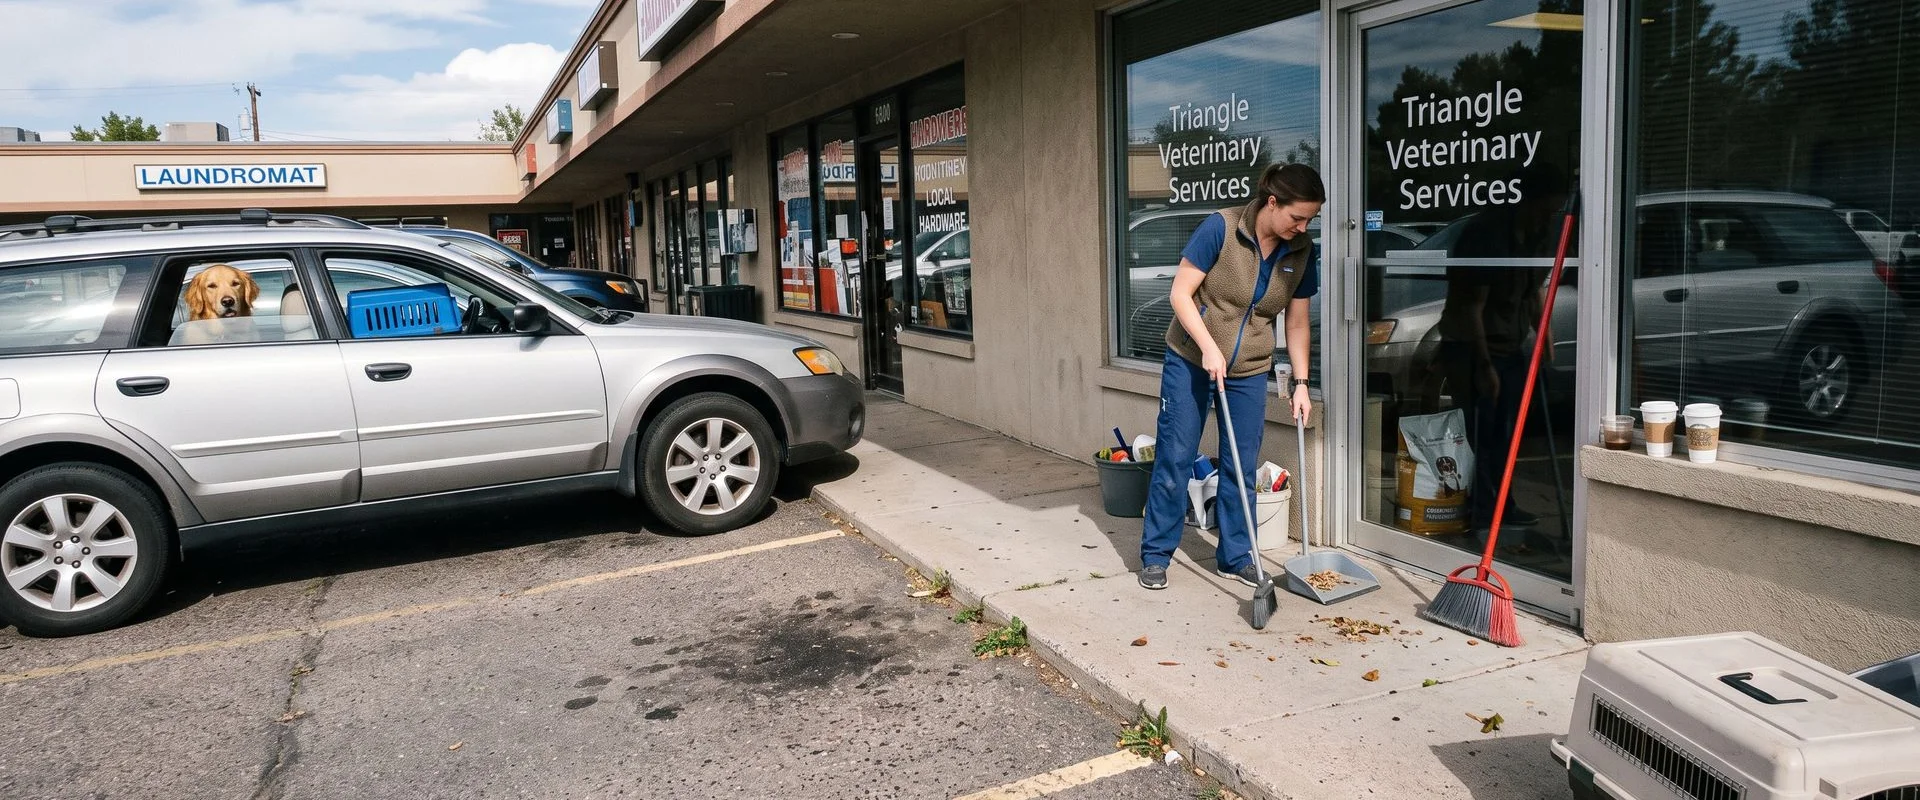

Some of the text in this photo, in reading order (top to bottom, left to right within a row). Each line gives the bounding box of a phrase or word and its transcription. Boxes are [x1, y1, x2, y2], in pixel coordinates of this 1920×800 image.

[1168, 92, 1249, 132] Triangle
[1401, 80, 1523, 128] Triangle
[1158, 135, 1262, 169] Veterinary
[1385, 130, 1542, 170] Veterinary
[141, 167, 318, 185] LAUNDROMAT
[1168, 172, 1251, 204] Services
[1399, 173, 1523, 210] Services
[925, 186, 957, 207] LOCAL
[919, 211, 967, 233] HARDWARE
